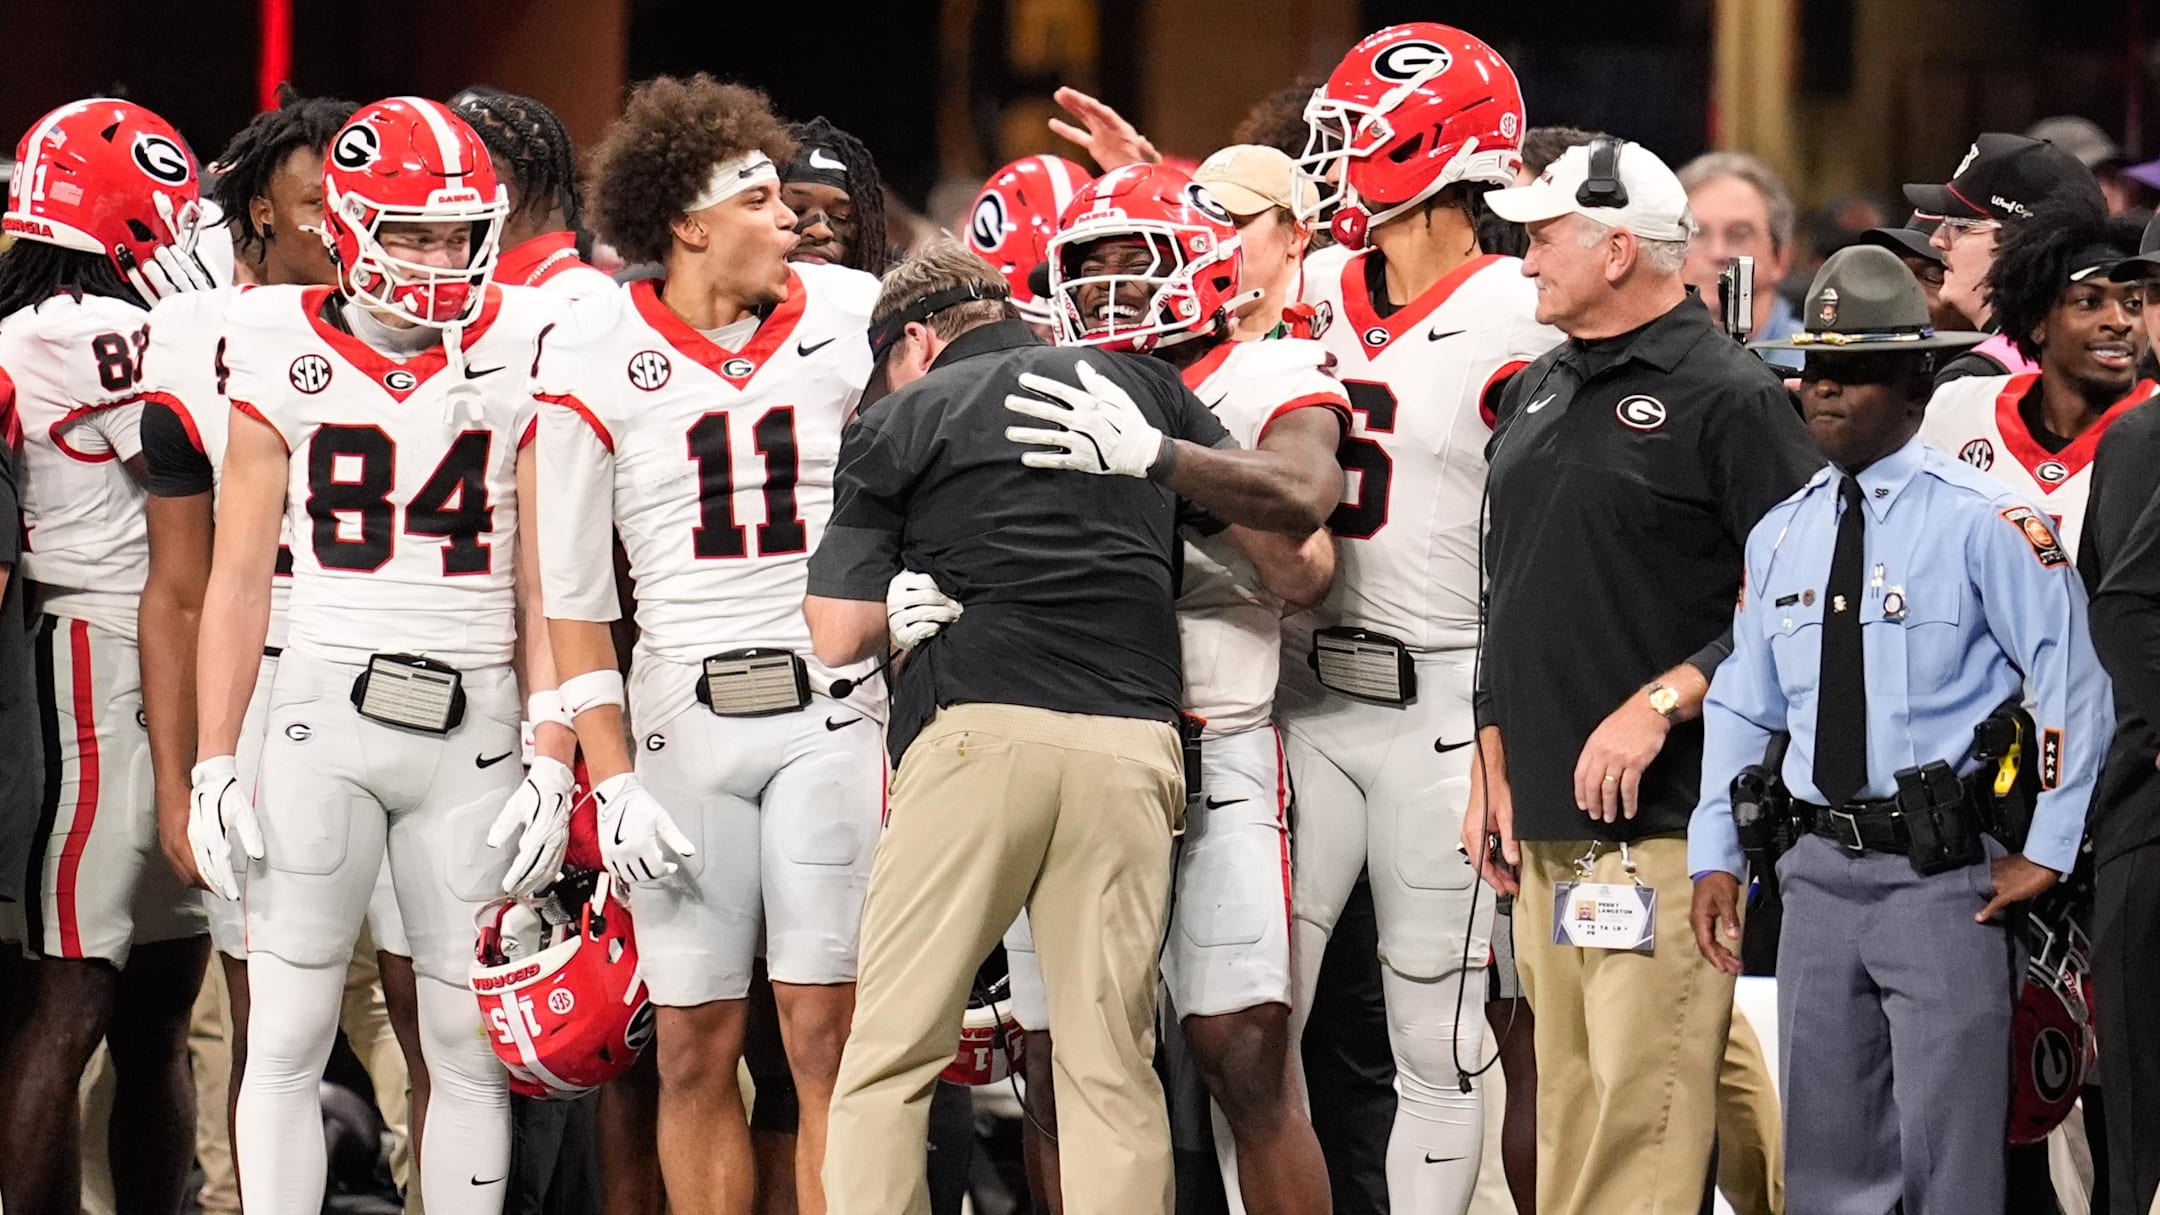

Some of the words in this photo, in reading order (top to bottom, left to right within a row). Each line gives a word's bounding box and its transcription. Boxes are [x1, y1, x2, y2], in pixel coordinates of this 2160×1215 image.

[1375, 43, 1449, 79] G
[134, 137, 187, 182] G
[334, 125, 376, 167] G
[973, 193, 1003, 247] G
[1188, 184, 1231, 222] G
[1365, 329, 1389, 345] G
[291, 355, 331, 393] SEC
[385, 372, 415, 389] G
[629, 351, 671, 390] SEC
[723, 359, 752, 376] G
[1620, 397, 1662, 426] G
[686, 404, 807, 559] 11
[2038, 463, 2065, 481] G
[305, 423, 495, 577] 84
[285, 723, 312, 741] G
[646, 733, 666, 752] G
[552, 991, 571, 1011] SEC
[2033, 1030, 2073, 1100] G
